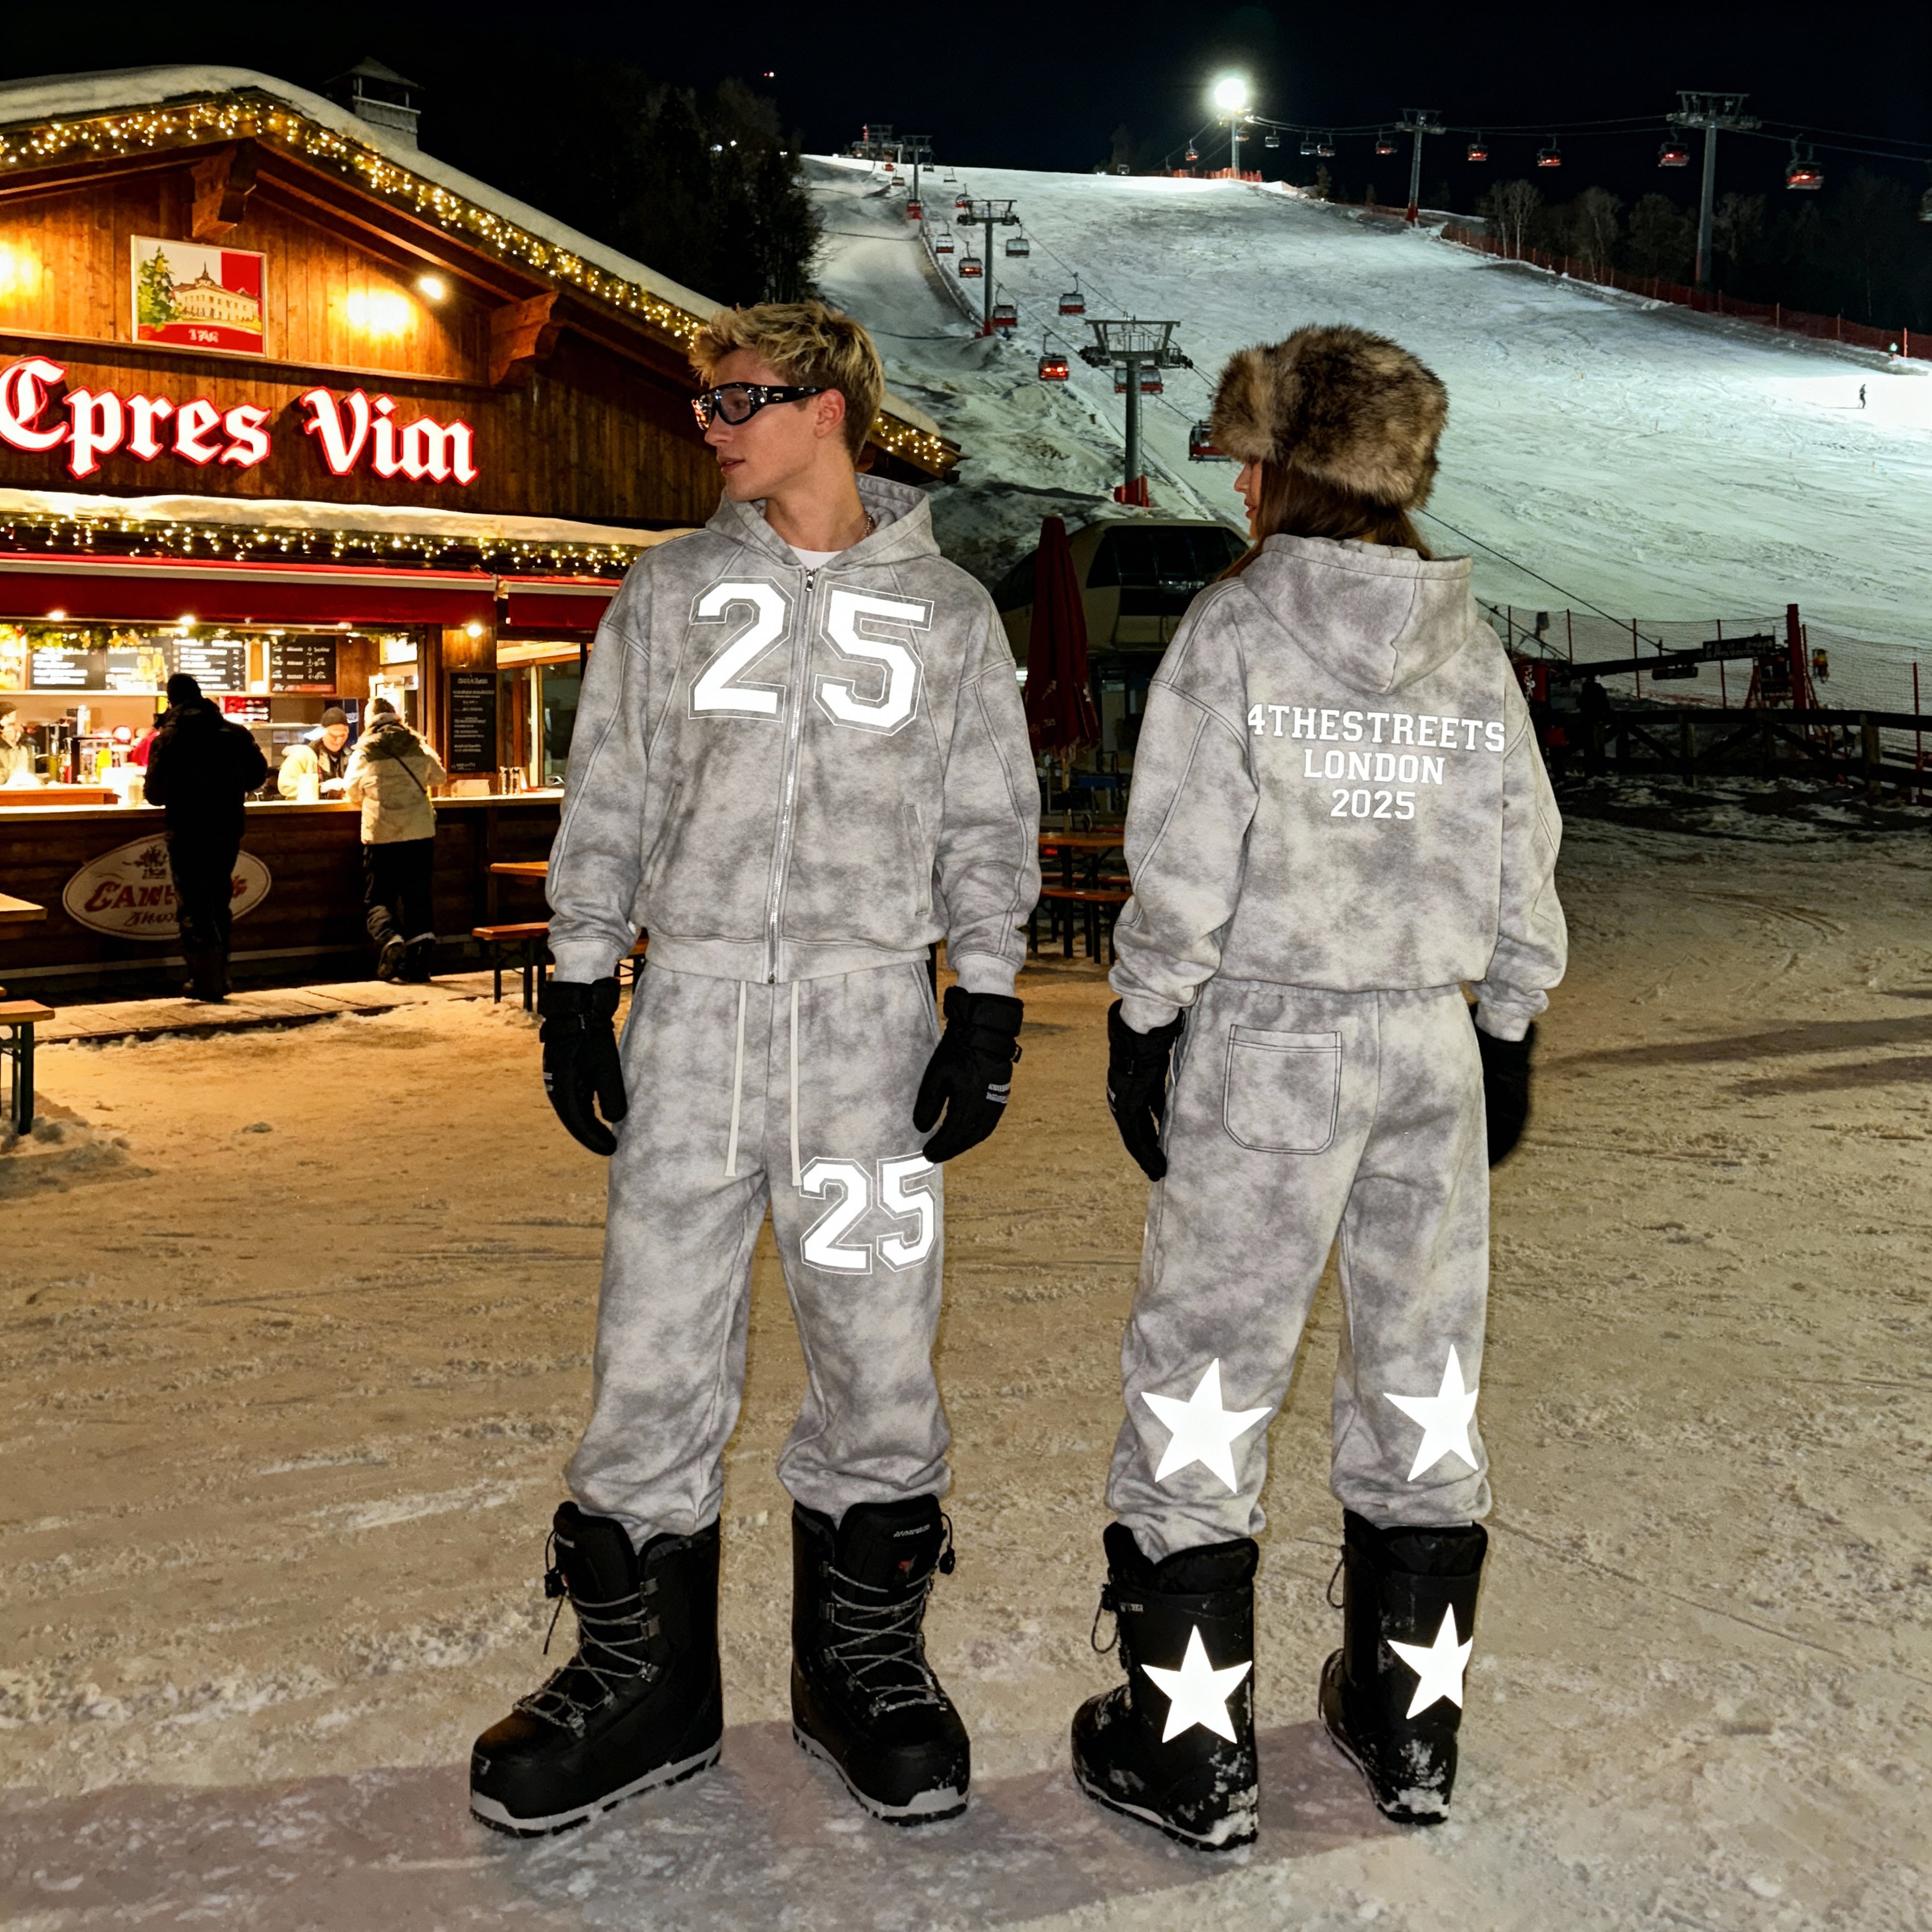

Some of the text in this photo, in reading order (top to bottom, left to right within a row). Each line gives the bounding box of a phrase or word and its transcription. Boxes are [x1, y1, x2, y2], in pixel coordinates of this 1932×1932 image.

[688, 576, 934, 736] 25
[1248, 703, 1505, 752] 4THESTREETS
[1304, 749, 1445, 785] LONDON
[1330, 788, 1416, 820] 2025
[799, 1151, 936, 1274] 25
